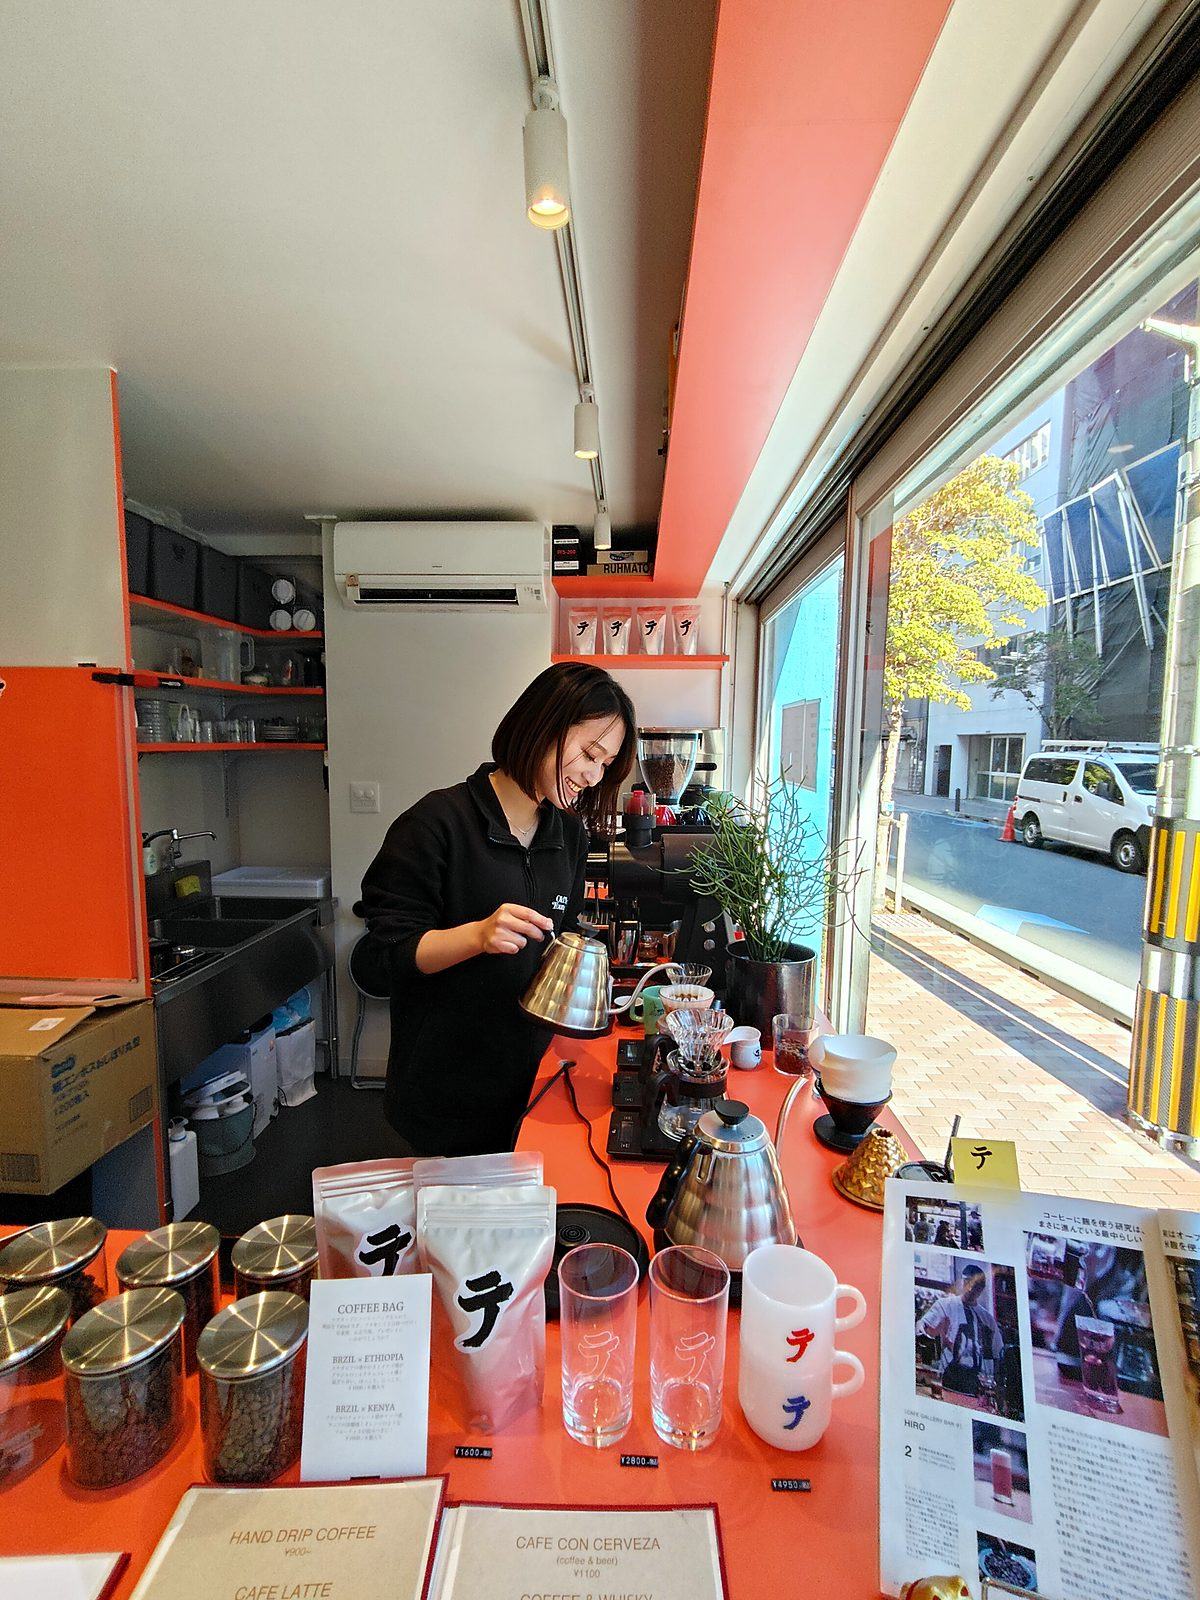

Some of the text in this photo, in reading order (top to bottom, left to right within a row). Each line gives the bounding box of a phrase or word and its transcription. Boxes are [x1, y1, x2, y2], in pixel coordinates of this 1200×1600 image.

[576, 621, 589, 636] テ
[611, 620, 622, 637] テ
[645, 620, 657, 635] テ
[680, 619, 691, 636] テ
[970, 1146, 992, 1170] テ
[337, 1301, 404, 1314] COFFEE BAG
[457, 1270, 514, 1348] テ
[786, 1327, 815, 1363] テ
[332, 1355, 356, 1364] BRZIL
[364, 1353, 404, 1363] ETHIOPIA
[577, 1330, 620, 1378] テ
[674, 1331, 716, 1383] テ
[335, 1405, 359, 1413] BRZIL
[367, 1403, 395, 1412] KENYA
[782, 1395, 812, 1430] テ
[904, 1419, 926, 1431] HIRO
[904, 1444, 912, 1458] 2
[229, 1525, 376, 1544] HAND DRIP COFFEE
[516, 1536, 661, 1551] CAFE CON CERVEZA
[556, 1556, 618, 1566] (coffee & beer)
[573, 1569, 600, 1578] ¥1100
[234, 1582, 333, 1600] CAFE LATTE
